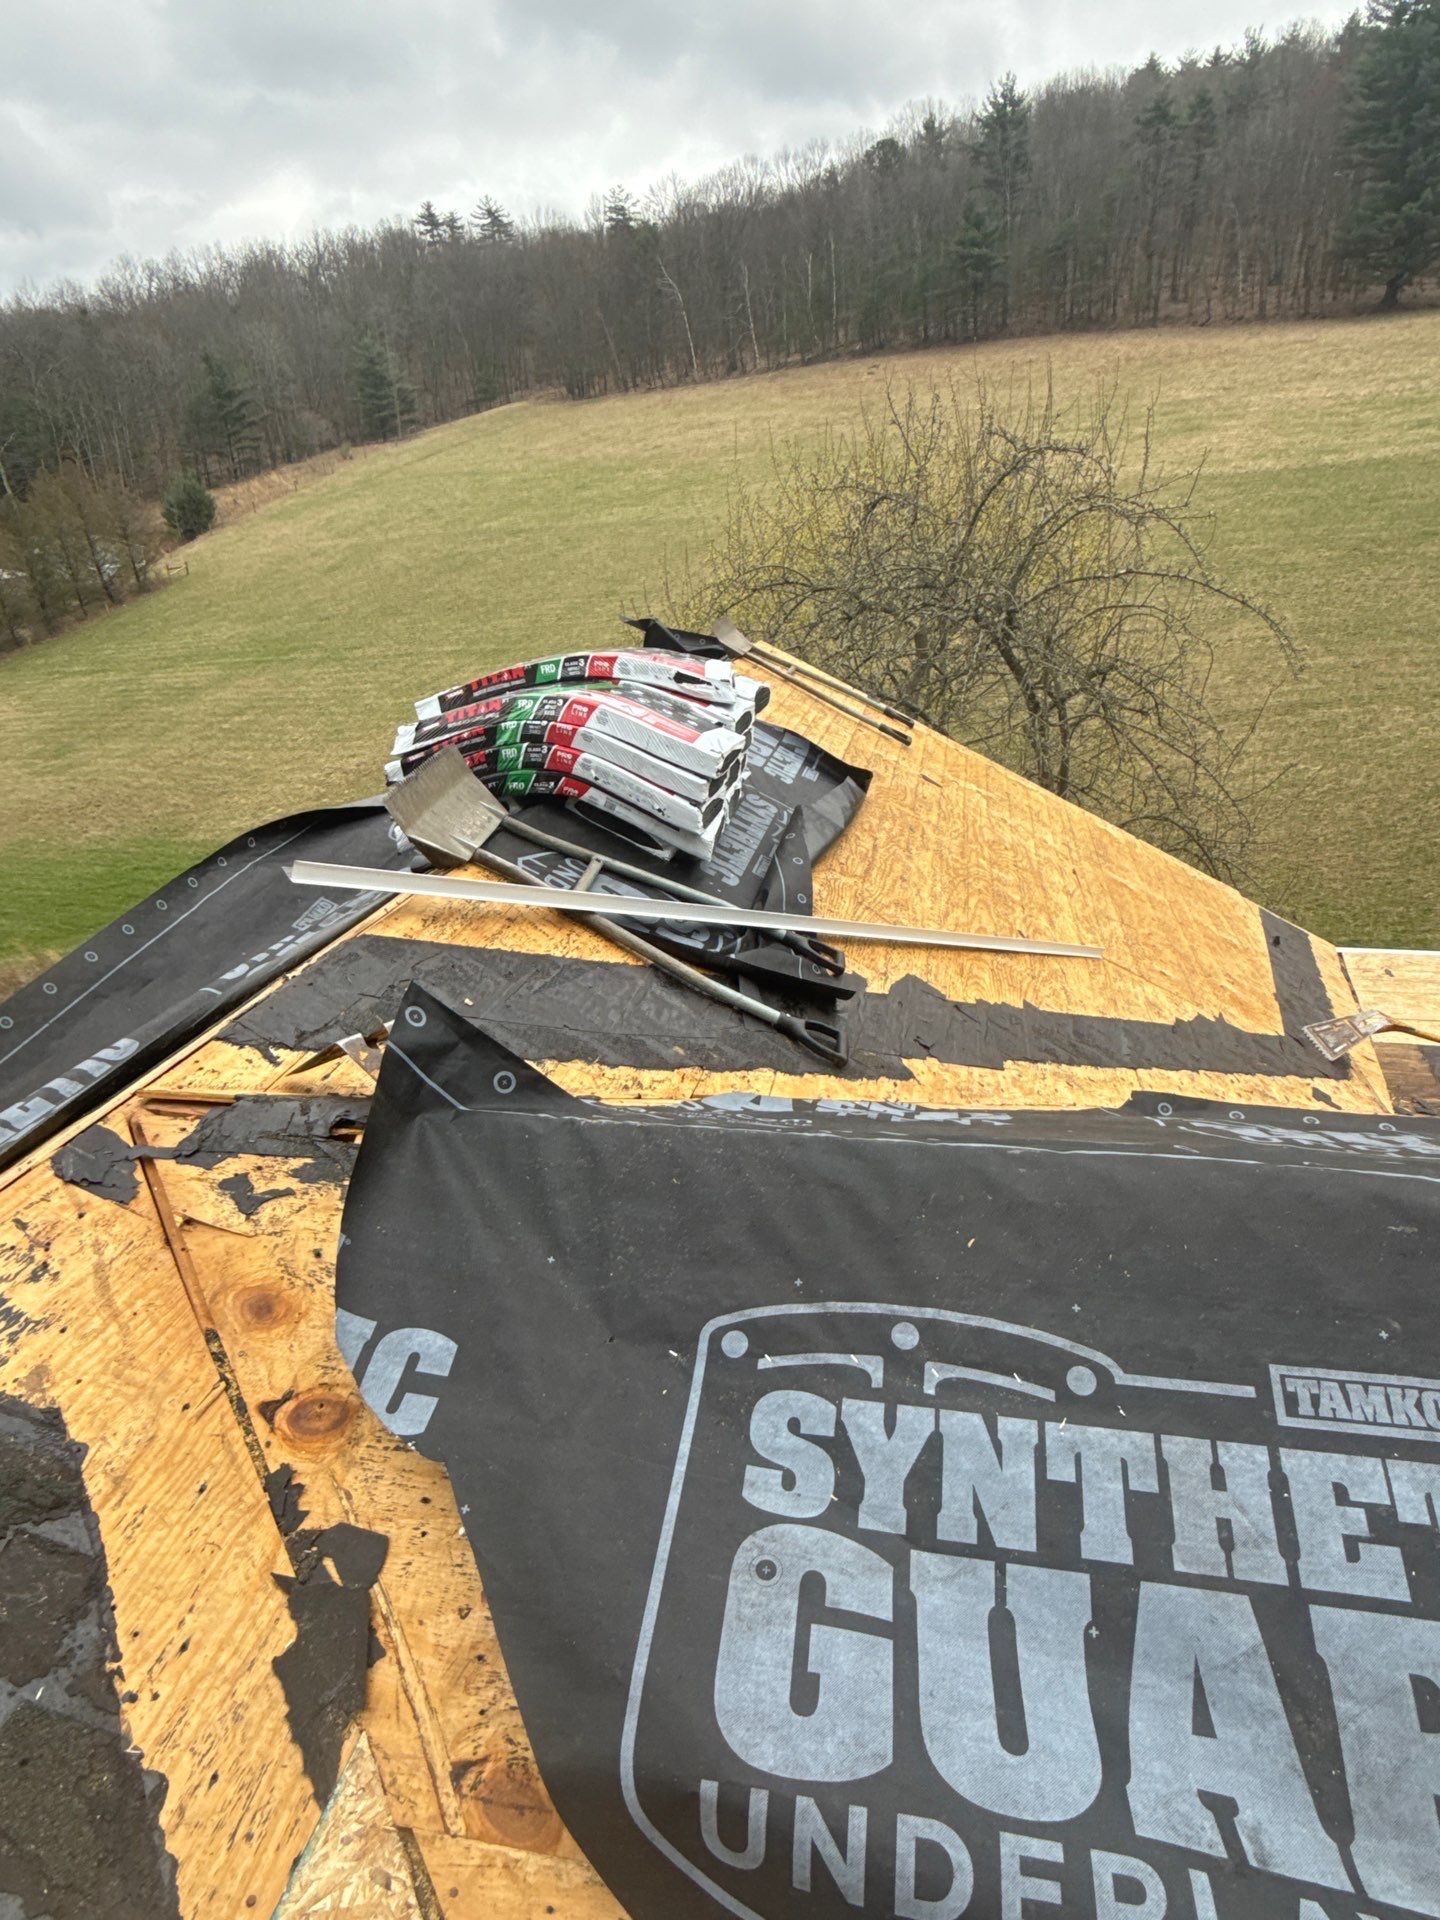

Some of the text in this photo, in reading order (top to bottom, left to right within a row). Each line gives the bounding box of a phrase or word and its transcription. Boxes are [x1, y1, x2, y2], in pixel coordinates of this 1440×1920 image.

[540, 663, 556, 675] FRD
[579, 659, 585, 667] 3
[470, 666, 525, 692] TITAN
[556, 698, 563, 706] 3
[446, 697, 503, 724] TITAN
[501, 748, 518, 760] FRD
[541, 745, 548, 754] 3
[701, 794, 778, 887] SYNTHETIC
